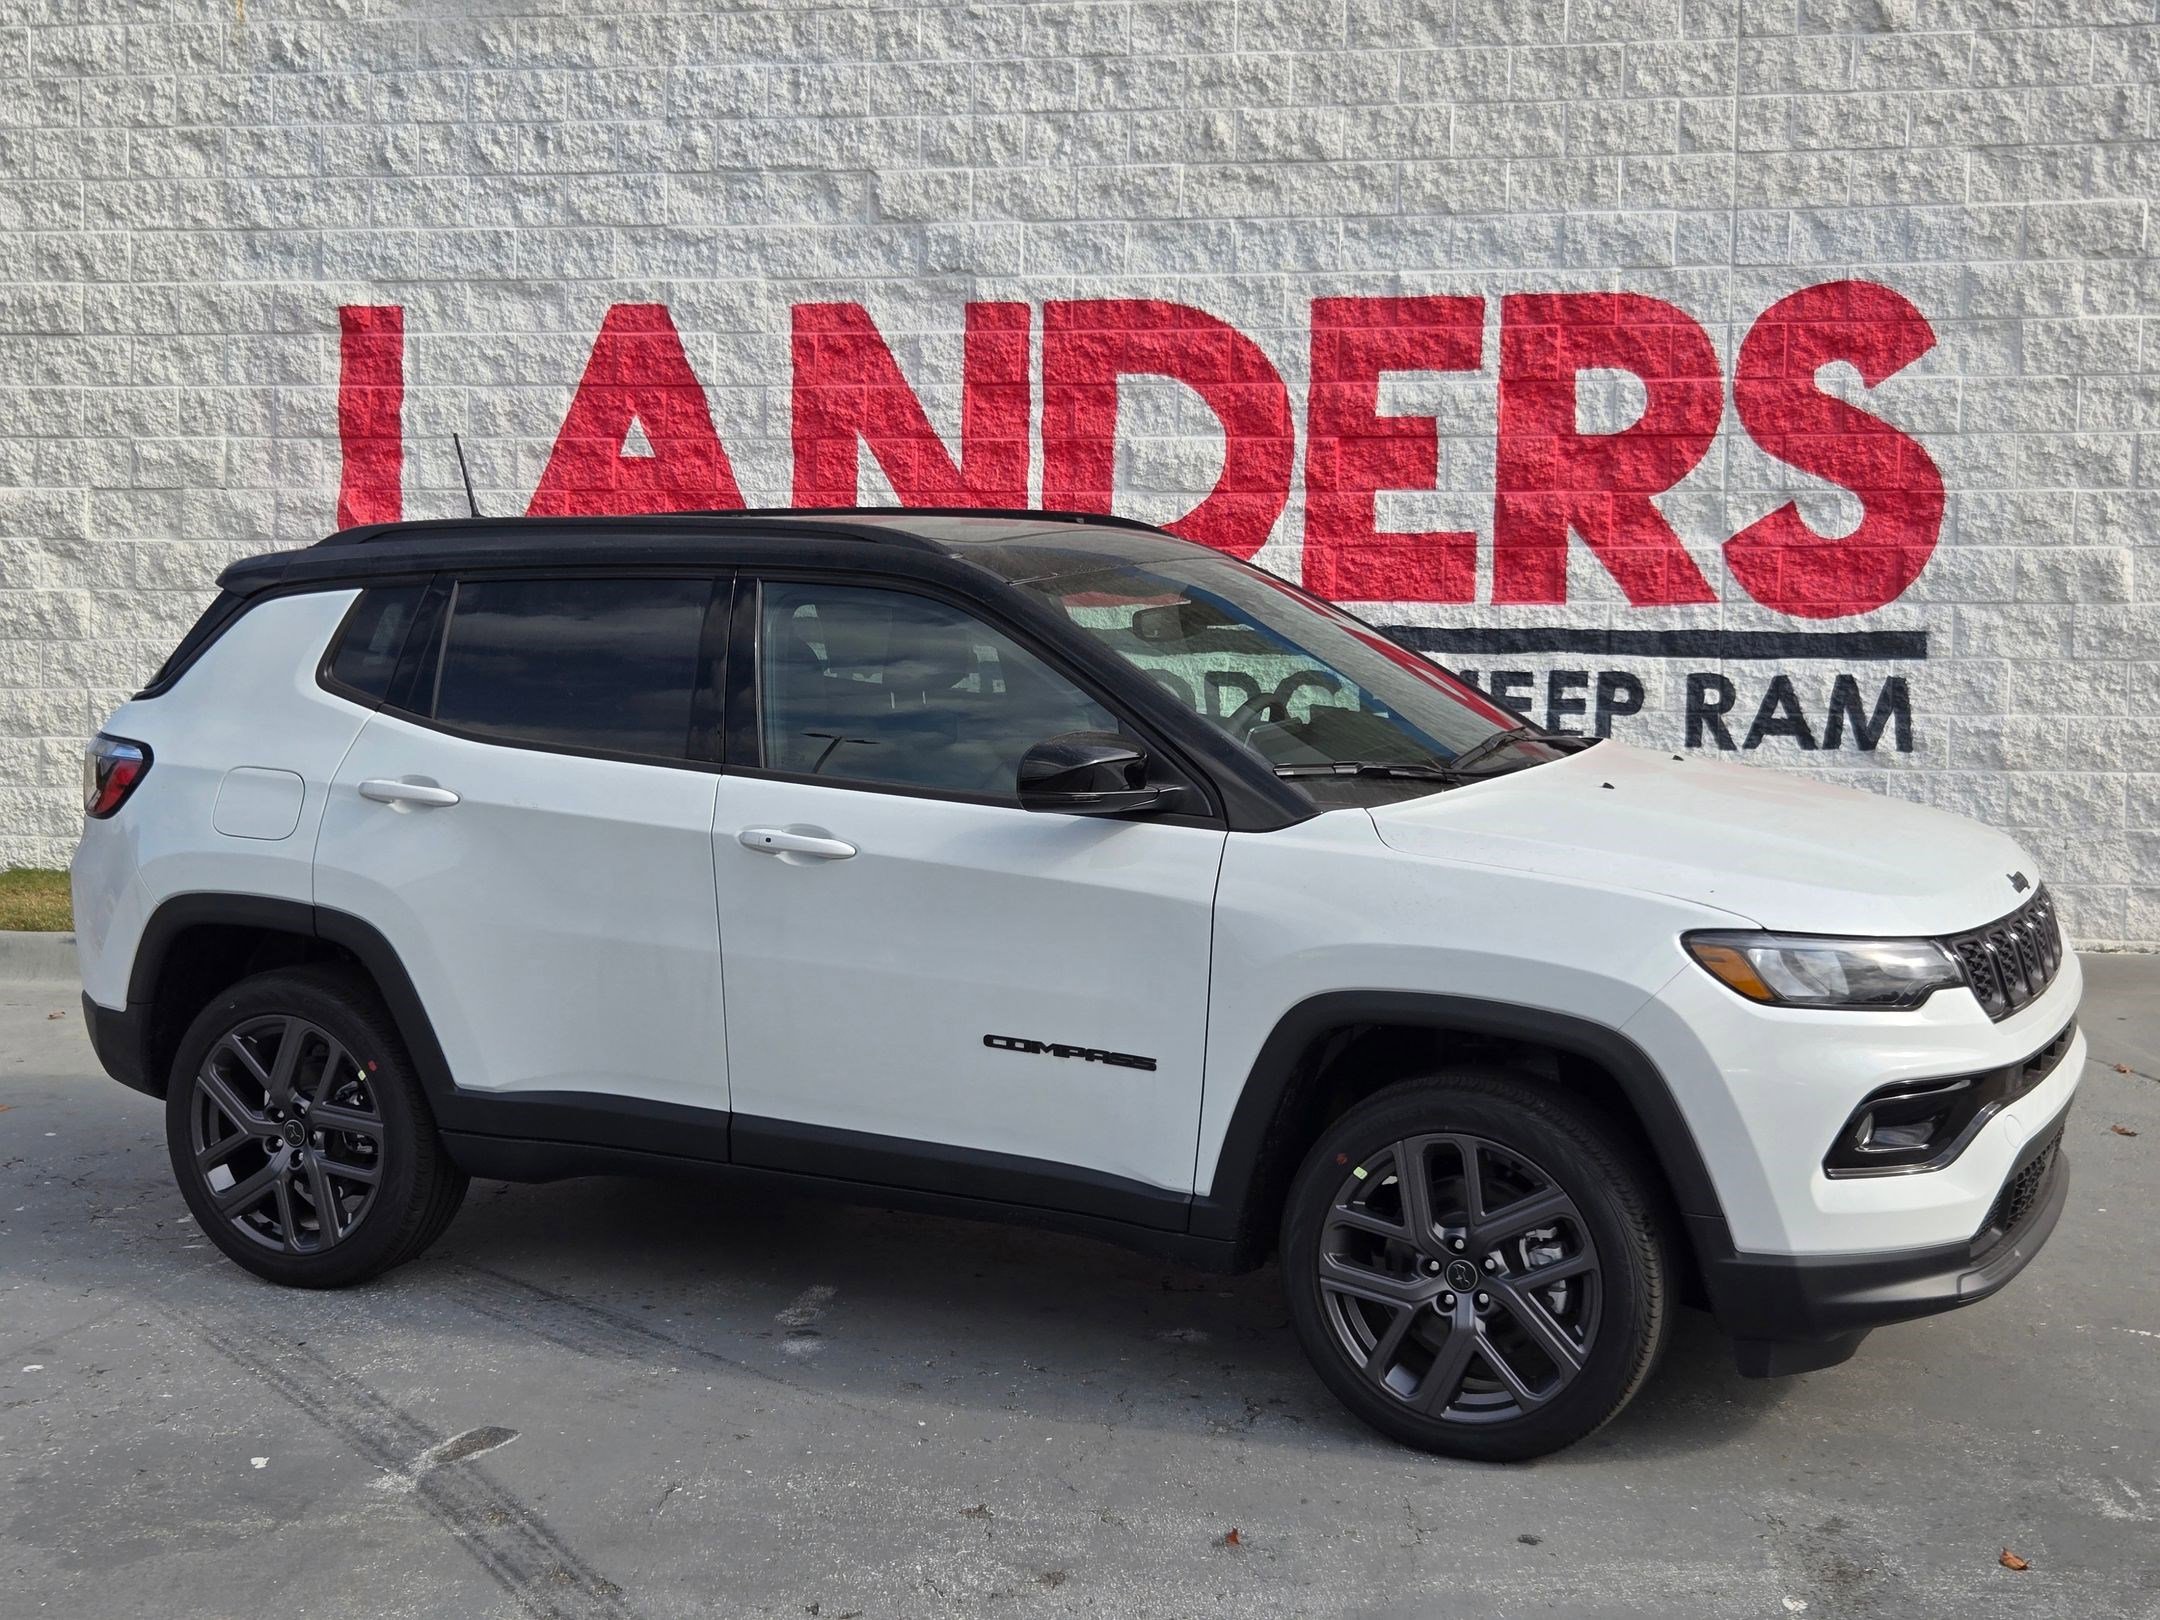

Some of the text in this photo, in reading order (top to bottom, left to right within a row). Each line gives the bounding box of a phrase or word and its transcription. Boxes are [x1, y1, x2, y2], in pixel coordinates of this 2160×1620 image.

[1459, 669, 1914, 753] EEP RAM
[983, 1034, 1157, 1071] COMPASS
